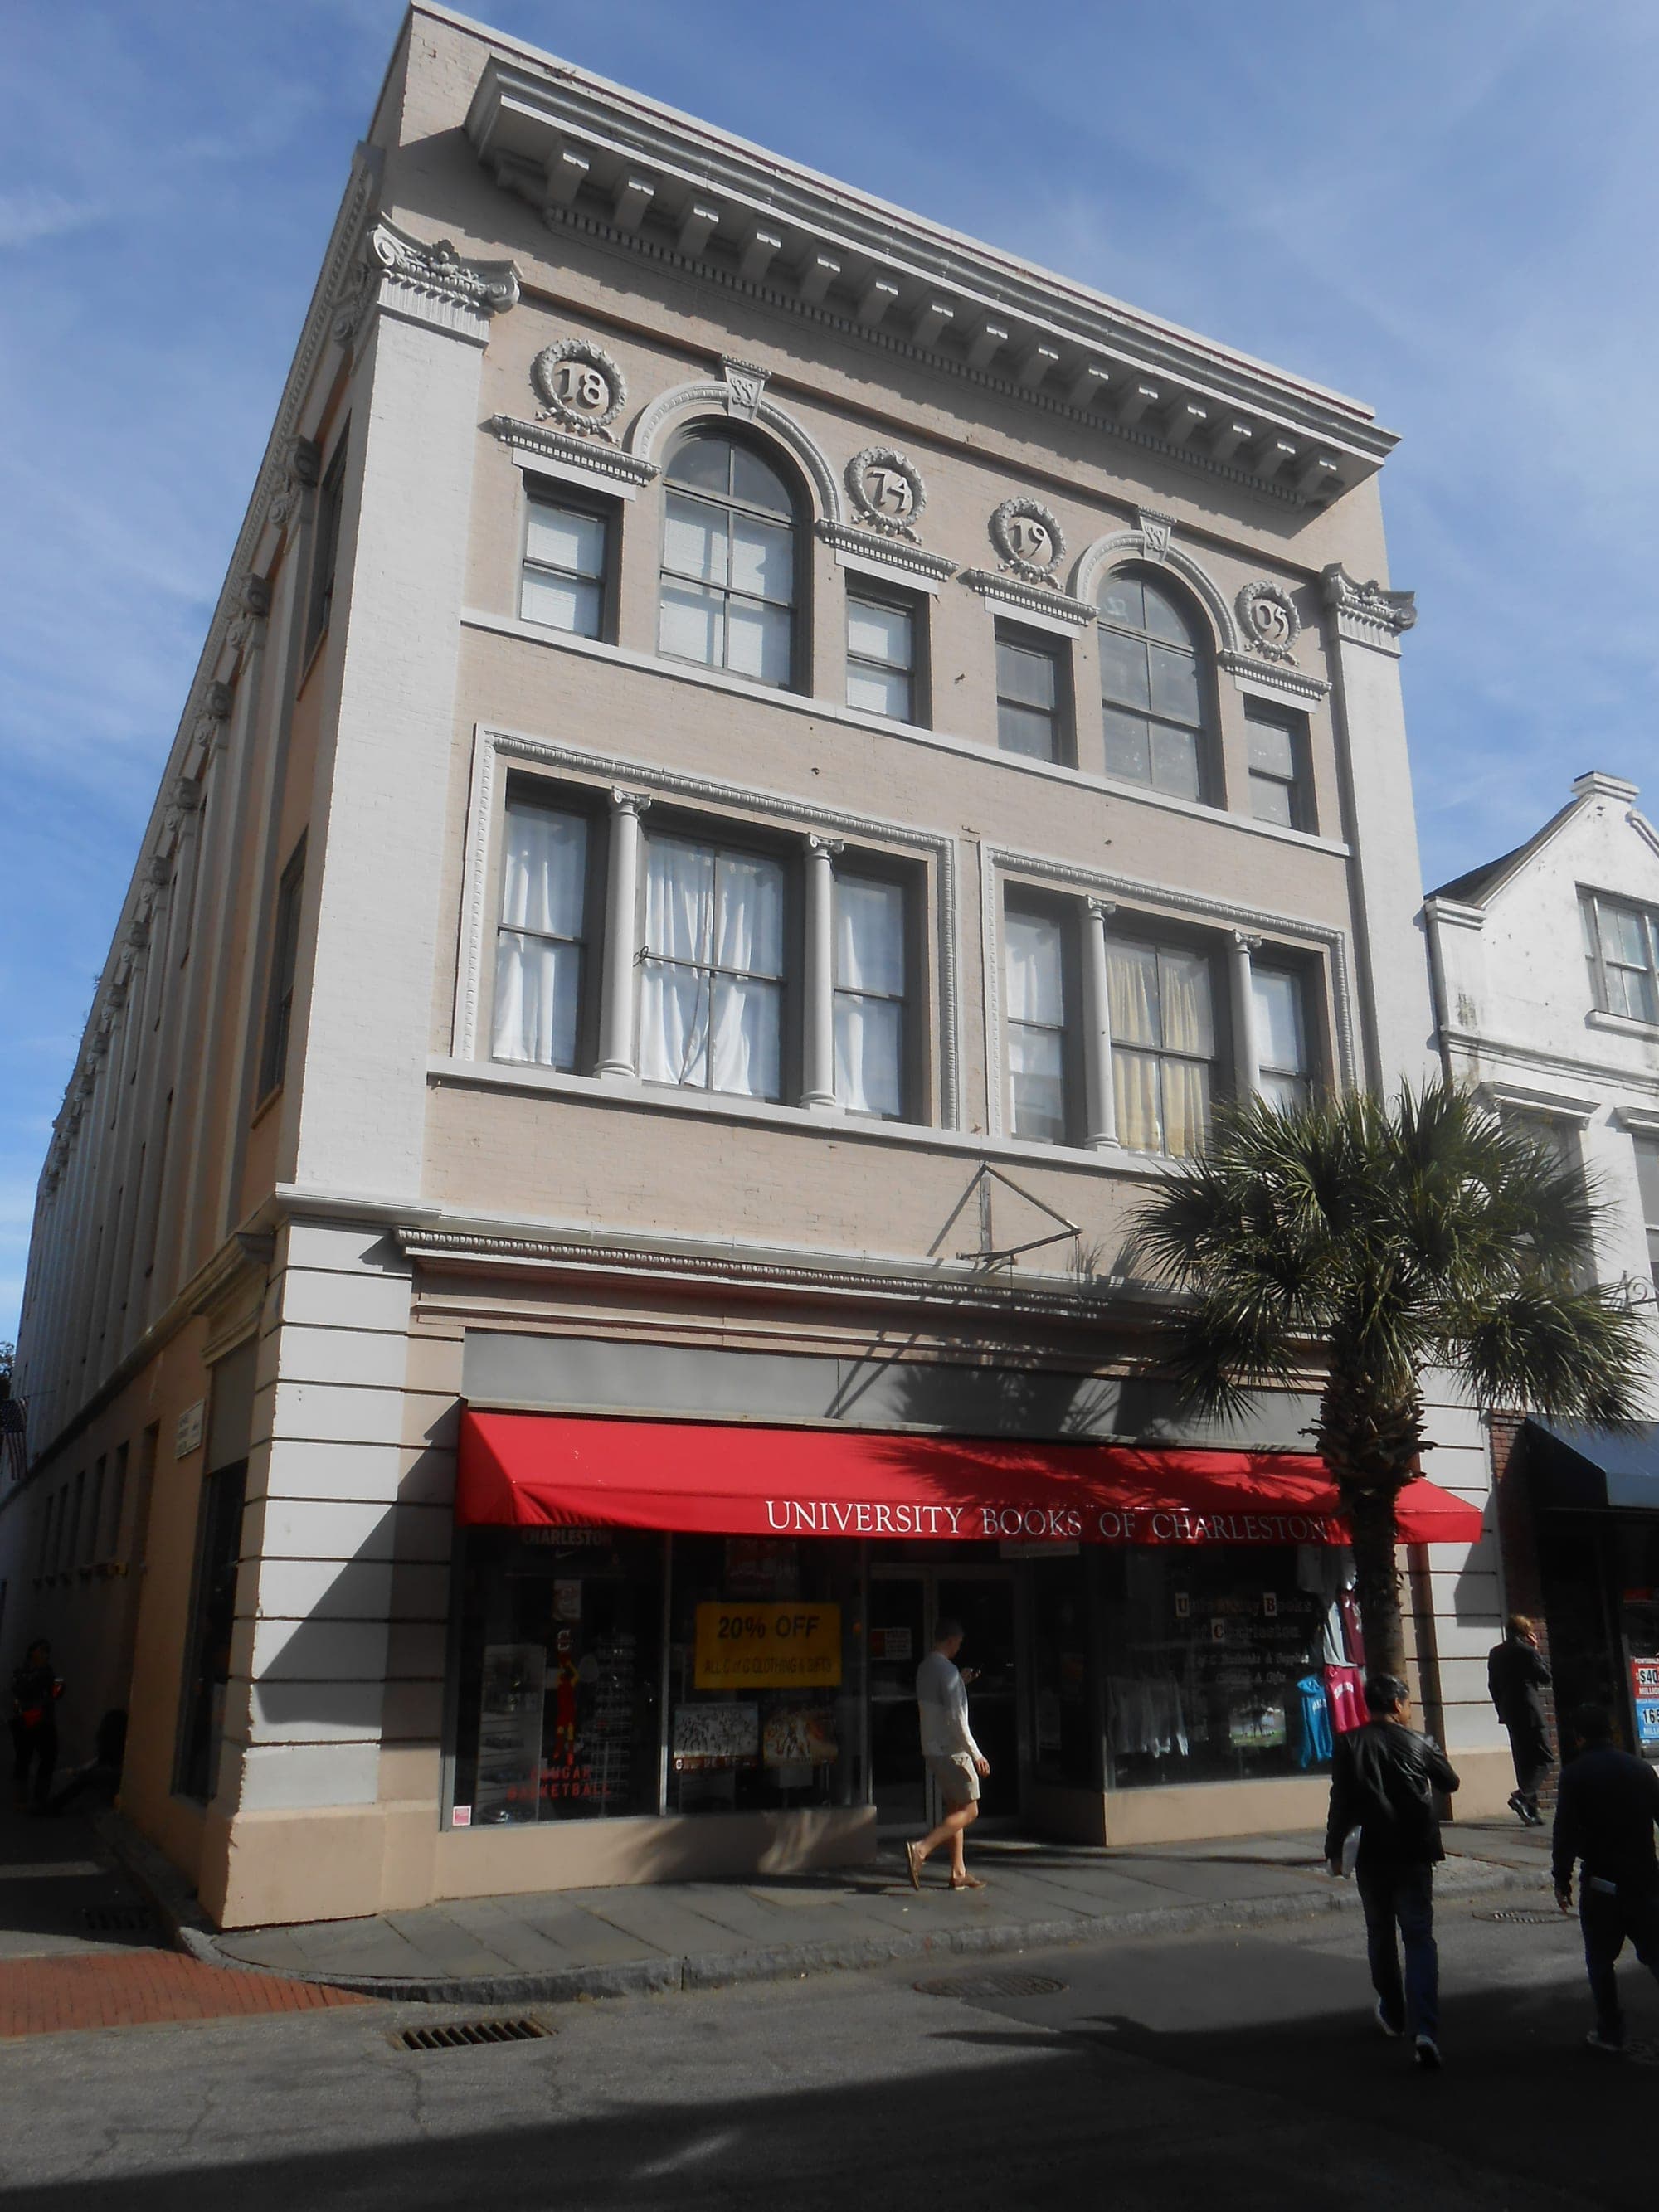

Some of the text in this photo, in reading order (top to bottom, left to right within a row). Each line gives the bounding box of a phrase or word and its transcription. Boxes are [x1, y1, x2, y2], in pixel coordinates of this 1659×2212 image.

[555, 367, 609, 408] 18
[868, 469, 912, 513] 74
[1009, 521, 1044, 558] 19
[1253, 603, 1288, 638] 05
[765, 1500, 1327, 1541] UNIVERSITY BOOKS OF CHARLESTON
[718, 1615, 820, 1639] 20% OFF
